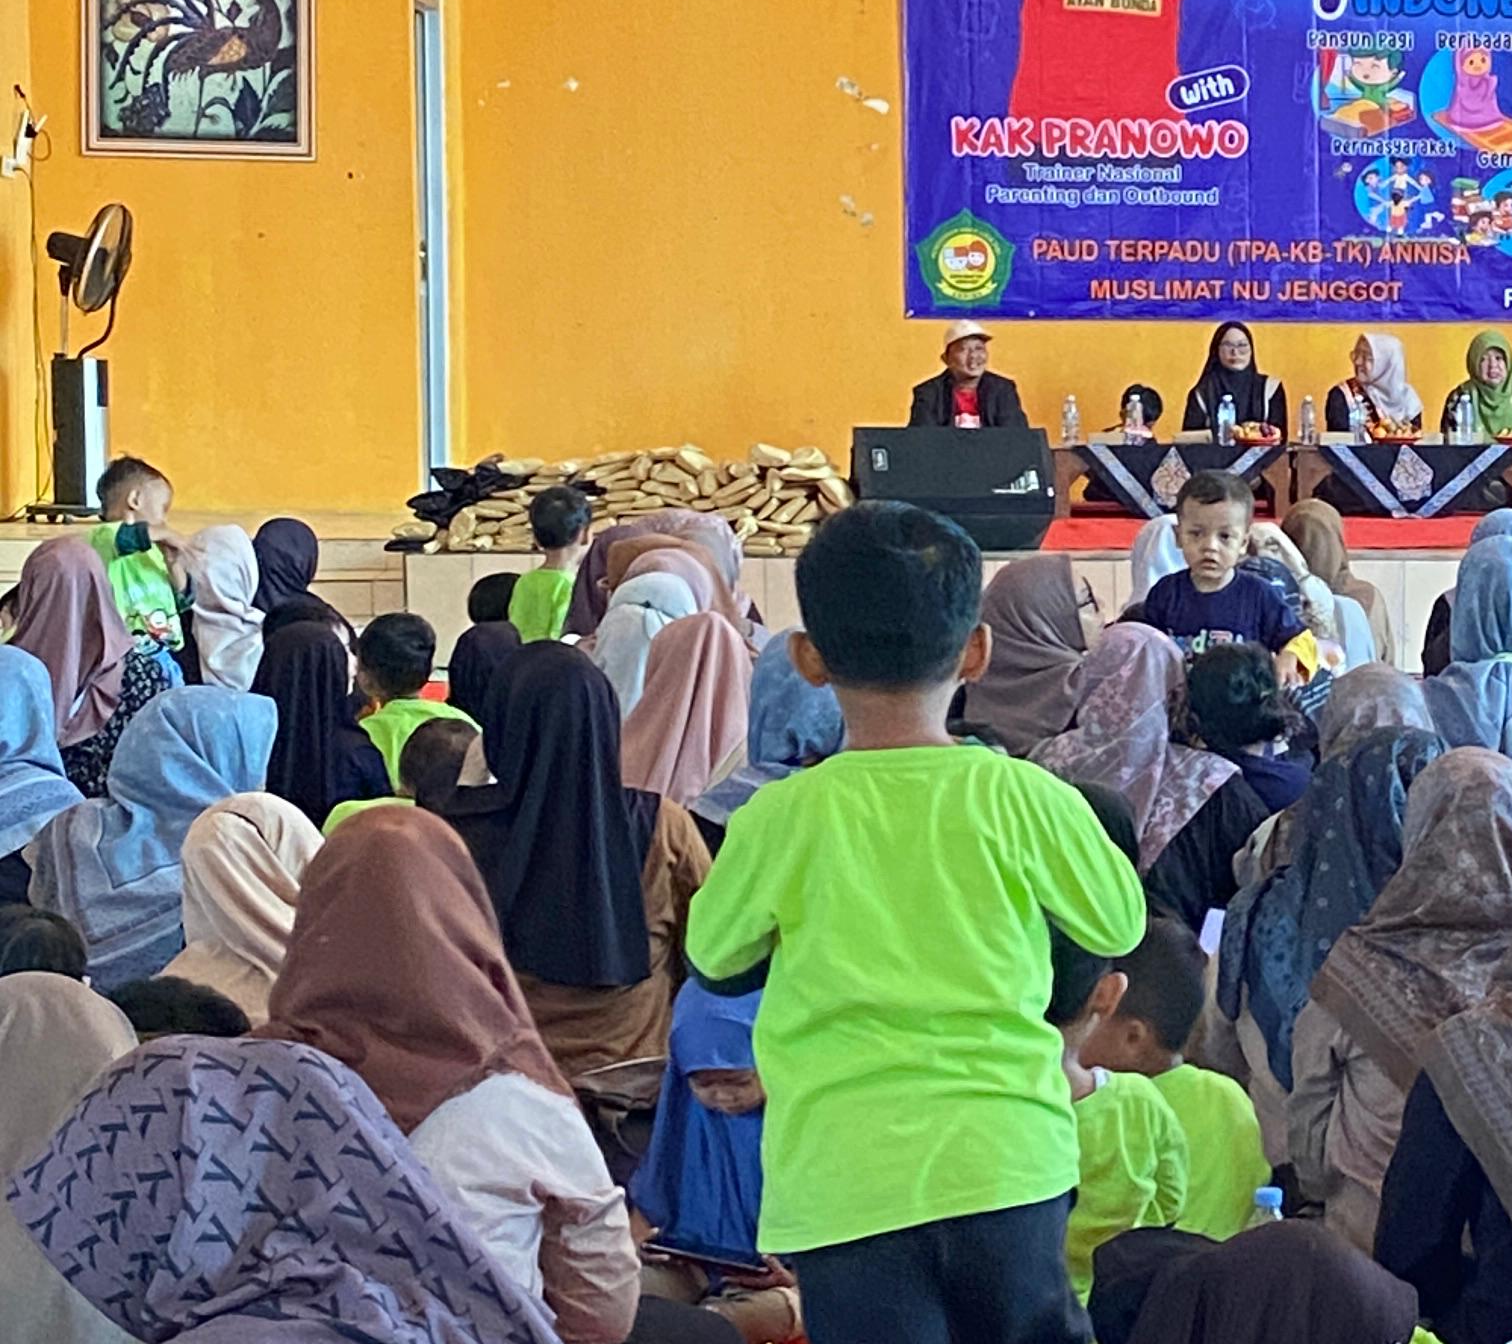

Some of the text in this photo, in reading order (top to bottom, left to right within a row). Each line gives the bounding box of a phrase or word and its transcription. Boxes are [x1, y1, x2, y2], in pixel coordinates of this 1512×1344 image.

[1180, 74, 1234, 105] with
[952, 117, 1248, 158] KAK PRANOWO
[1332, 138, 1456, 156] Bermasyarakat
[1022, 163, 1182, 183] Trainer Nasional
[986, 185, 1219, 207] Parenting dan Outbound
[1033, 239, 1471, 267] PAUD TERPADU (TPA-KB-TK) ANNISA
[1091, 279, 1402, 301] MUSLIMAT NU JENGGOT
